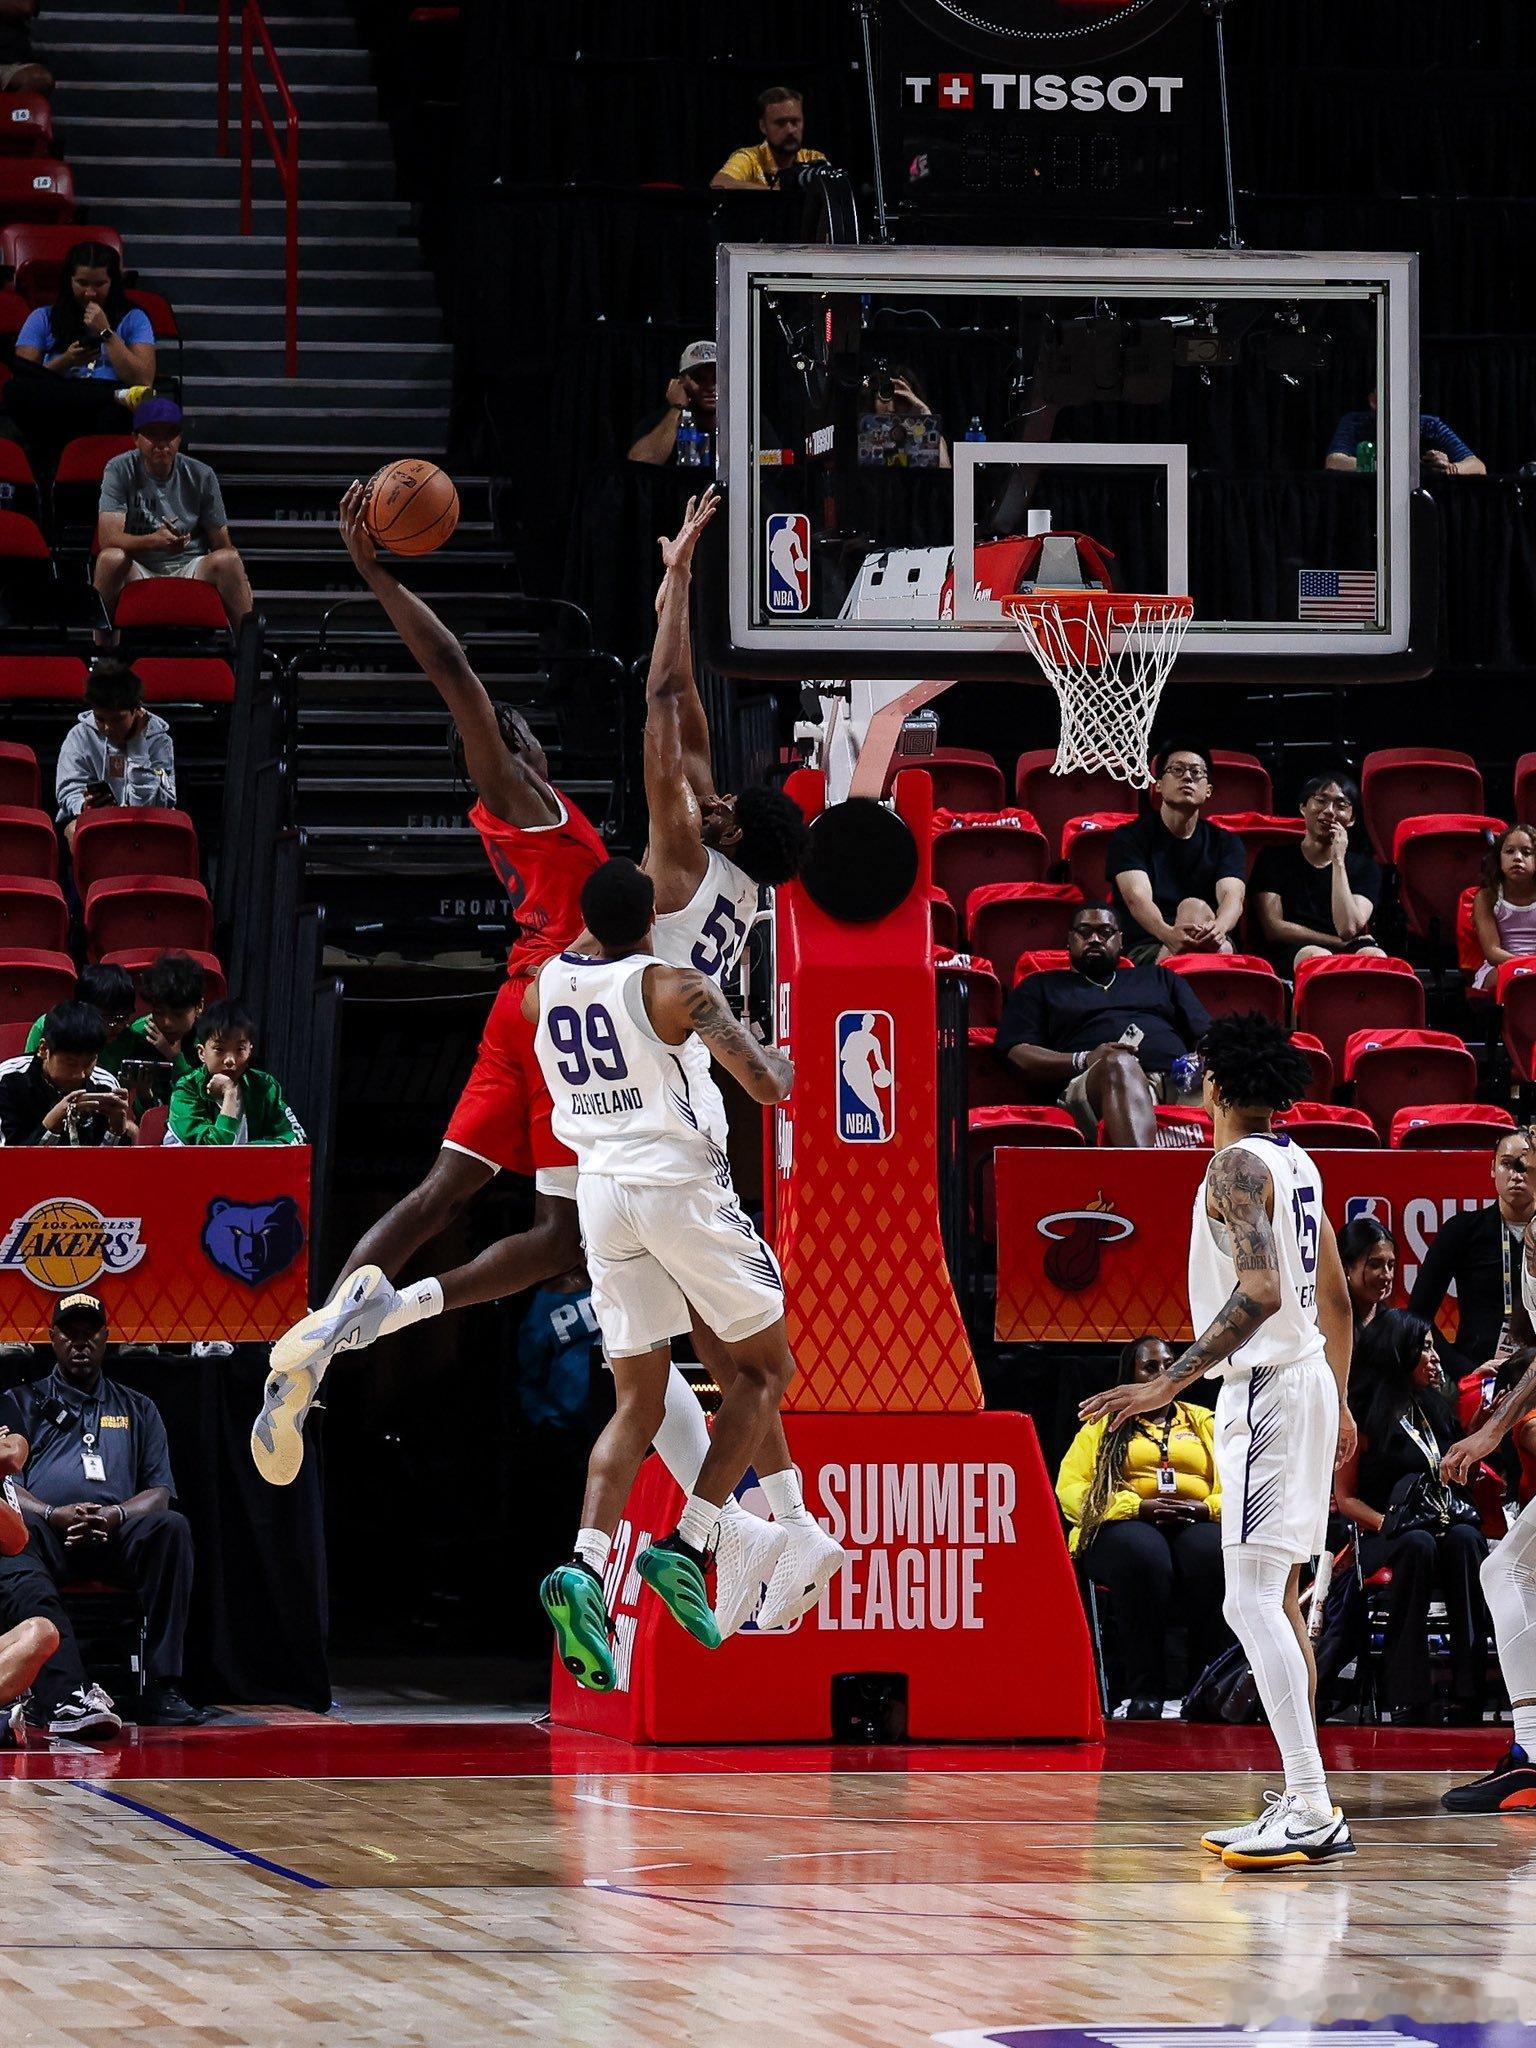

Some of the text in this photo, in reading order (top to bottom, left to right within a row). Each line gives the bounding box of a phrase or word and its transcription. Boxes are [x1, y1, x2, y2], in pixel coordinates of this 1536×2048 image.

[981, 74, 1184, 112] TISSOT
[773, 590, 794, 606] NBA
[440, 899, 512, 915] FRONT
[548, 1003, 628, 1085] 99
[571, 1087, 643, 1116] CLEVELAND
[845, 1113, 873, 1134] NBA
[1154, 1123, 1205, 1148] UMMER
[41, 1221, 136, 1229] LOS ANGELES
[1292, 1186, 1317, 1273] 15
[2, 1221, 140, 1268] LAKERS
[818, 1463, 1017, 1545] SUMMER
[818, 1548, 984, 1630] LEAGUE
